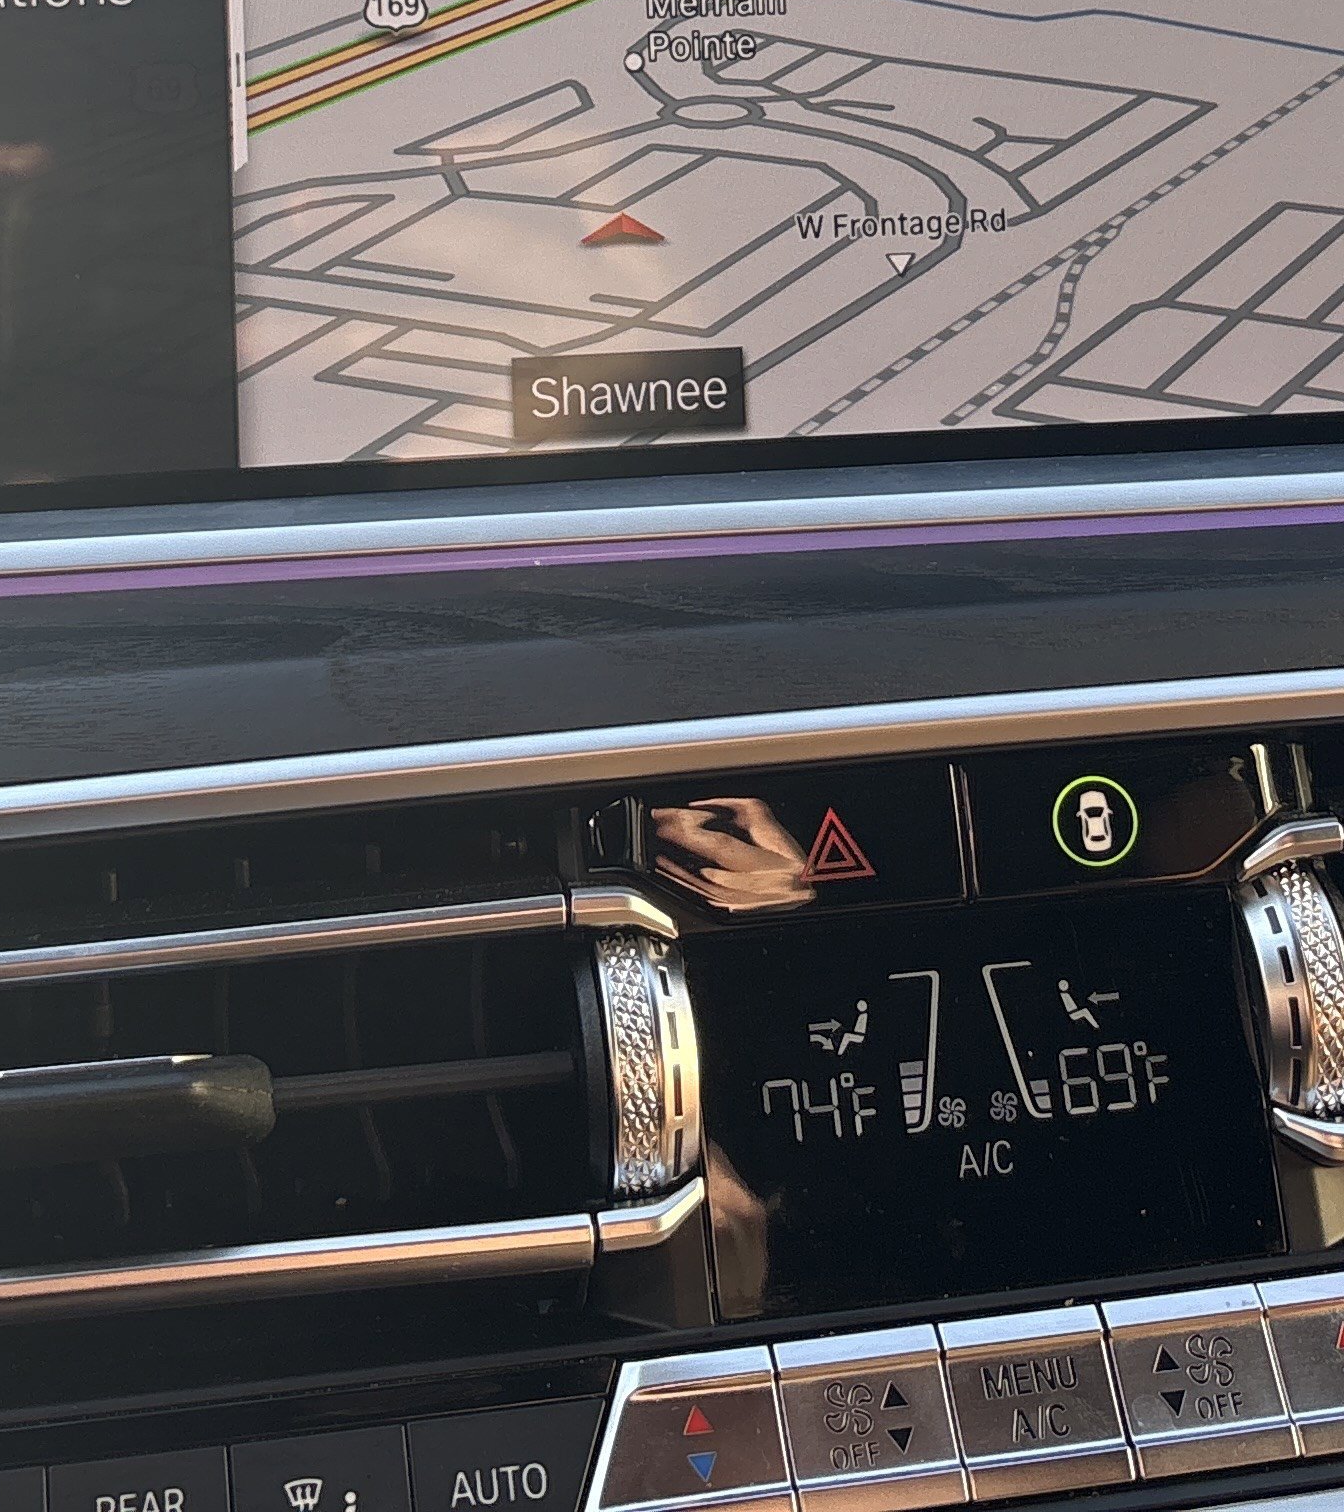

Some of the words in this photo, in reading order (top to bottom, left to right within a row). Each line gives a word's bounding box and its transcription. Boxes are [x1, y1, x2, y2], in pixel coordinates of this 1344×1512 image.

[647, 31, 757, 65] Pointe
[796, 212, 826, 241] W
[831, 211, 962, 245] Frontage
[968, 207, 1008, 234] Rd
[531, 373, 728, 418] Shawnee
[958, 1139, 1015, 1179] A/C
[981, 1355, 1078, 1400] MENU
[1012, 1402, 1072, 1443] A/C
[1194, 1390, 1243, 1420] OFF
[829, 1441, 880, 1470] OFF
[449, 1462, 549, 1506] AUTO
